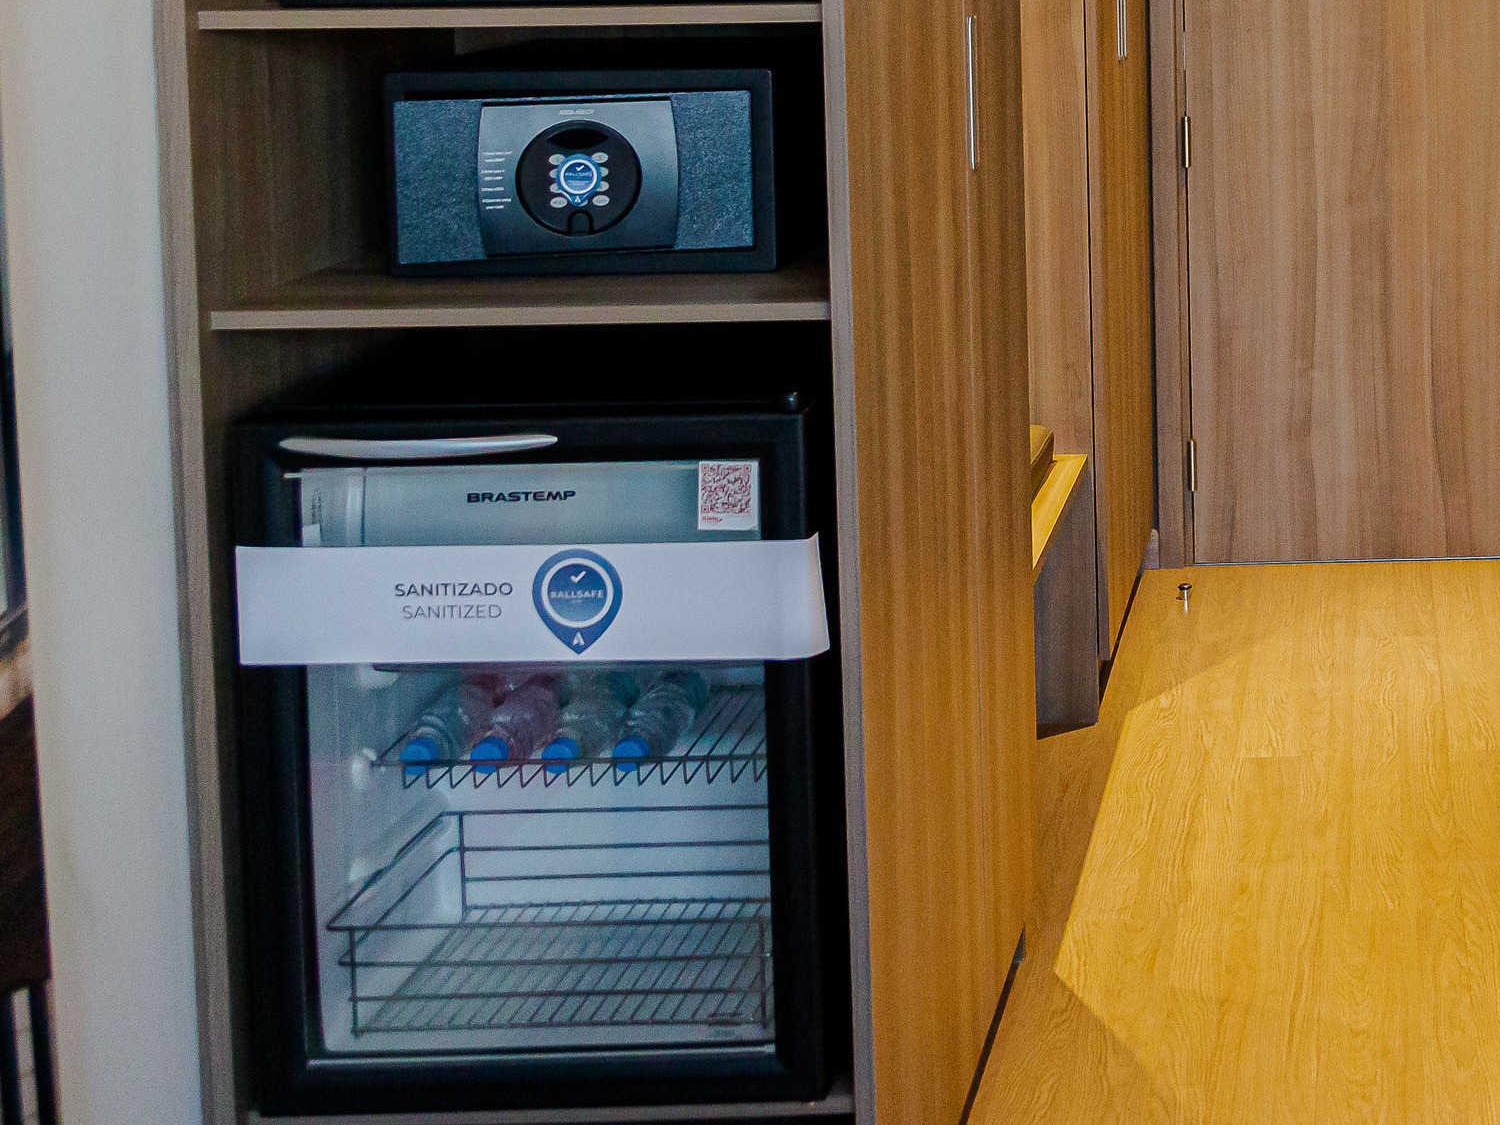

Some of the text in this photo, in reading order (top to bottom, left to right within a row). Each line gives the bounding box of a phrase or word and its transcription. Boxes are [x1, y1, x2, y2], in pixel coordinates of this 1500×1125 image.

[466, 490, 577, 504] BRASTEMP
[394, 582, 514, 597] SANITIZADO
[401, 603, 503, 619] SANITIZED
